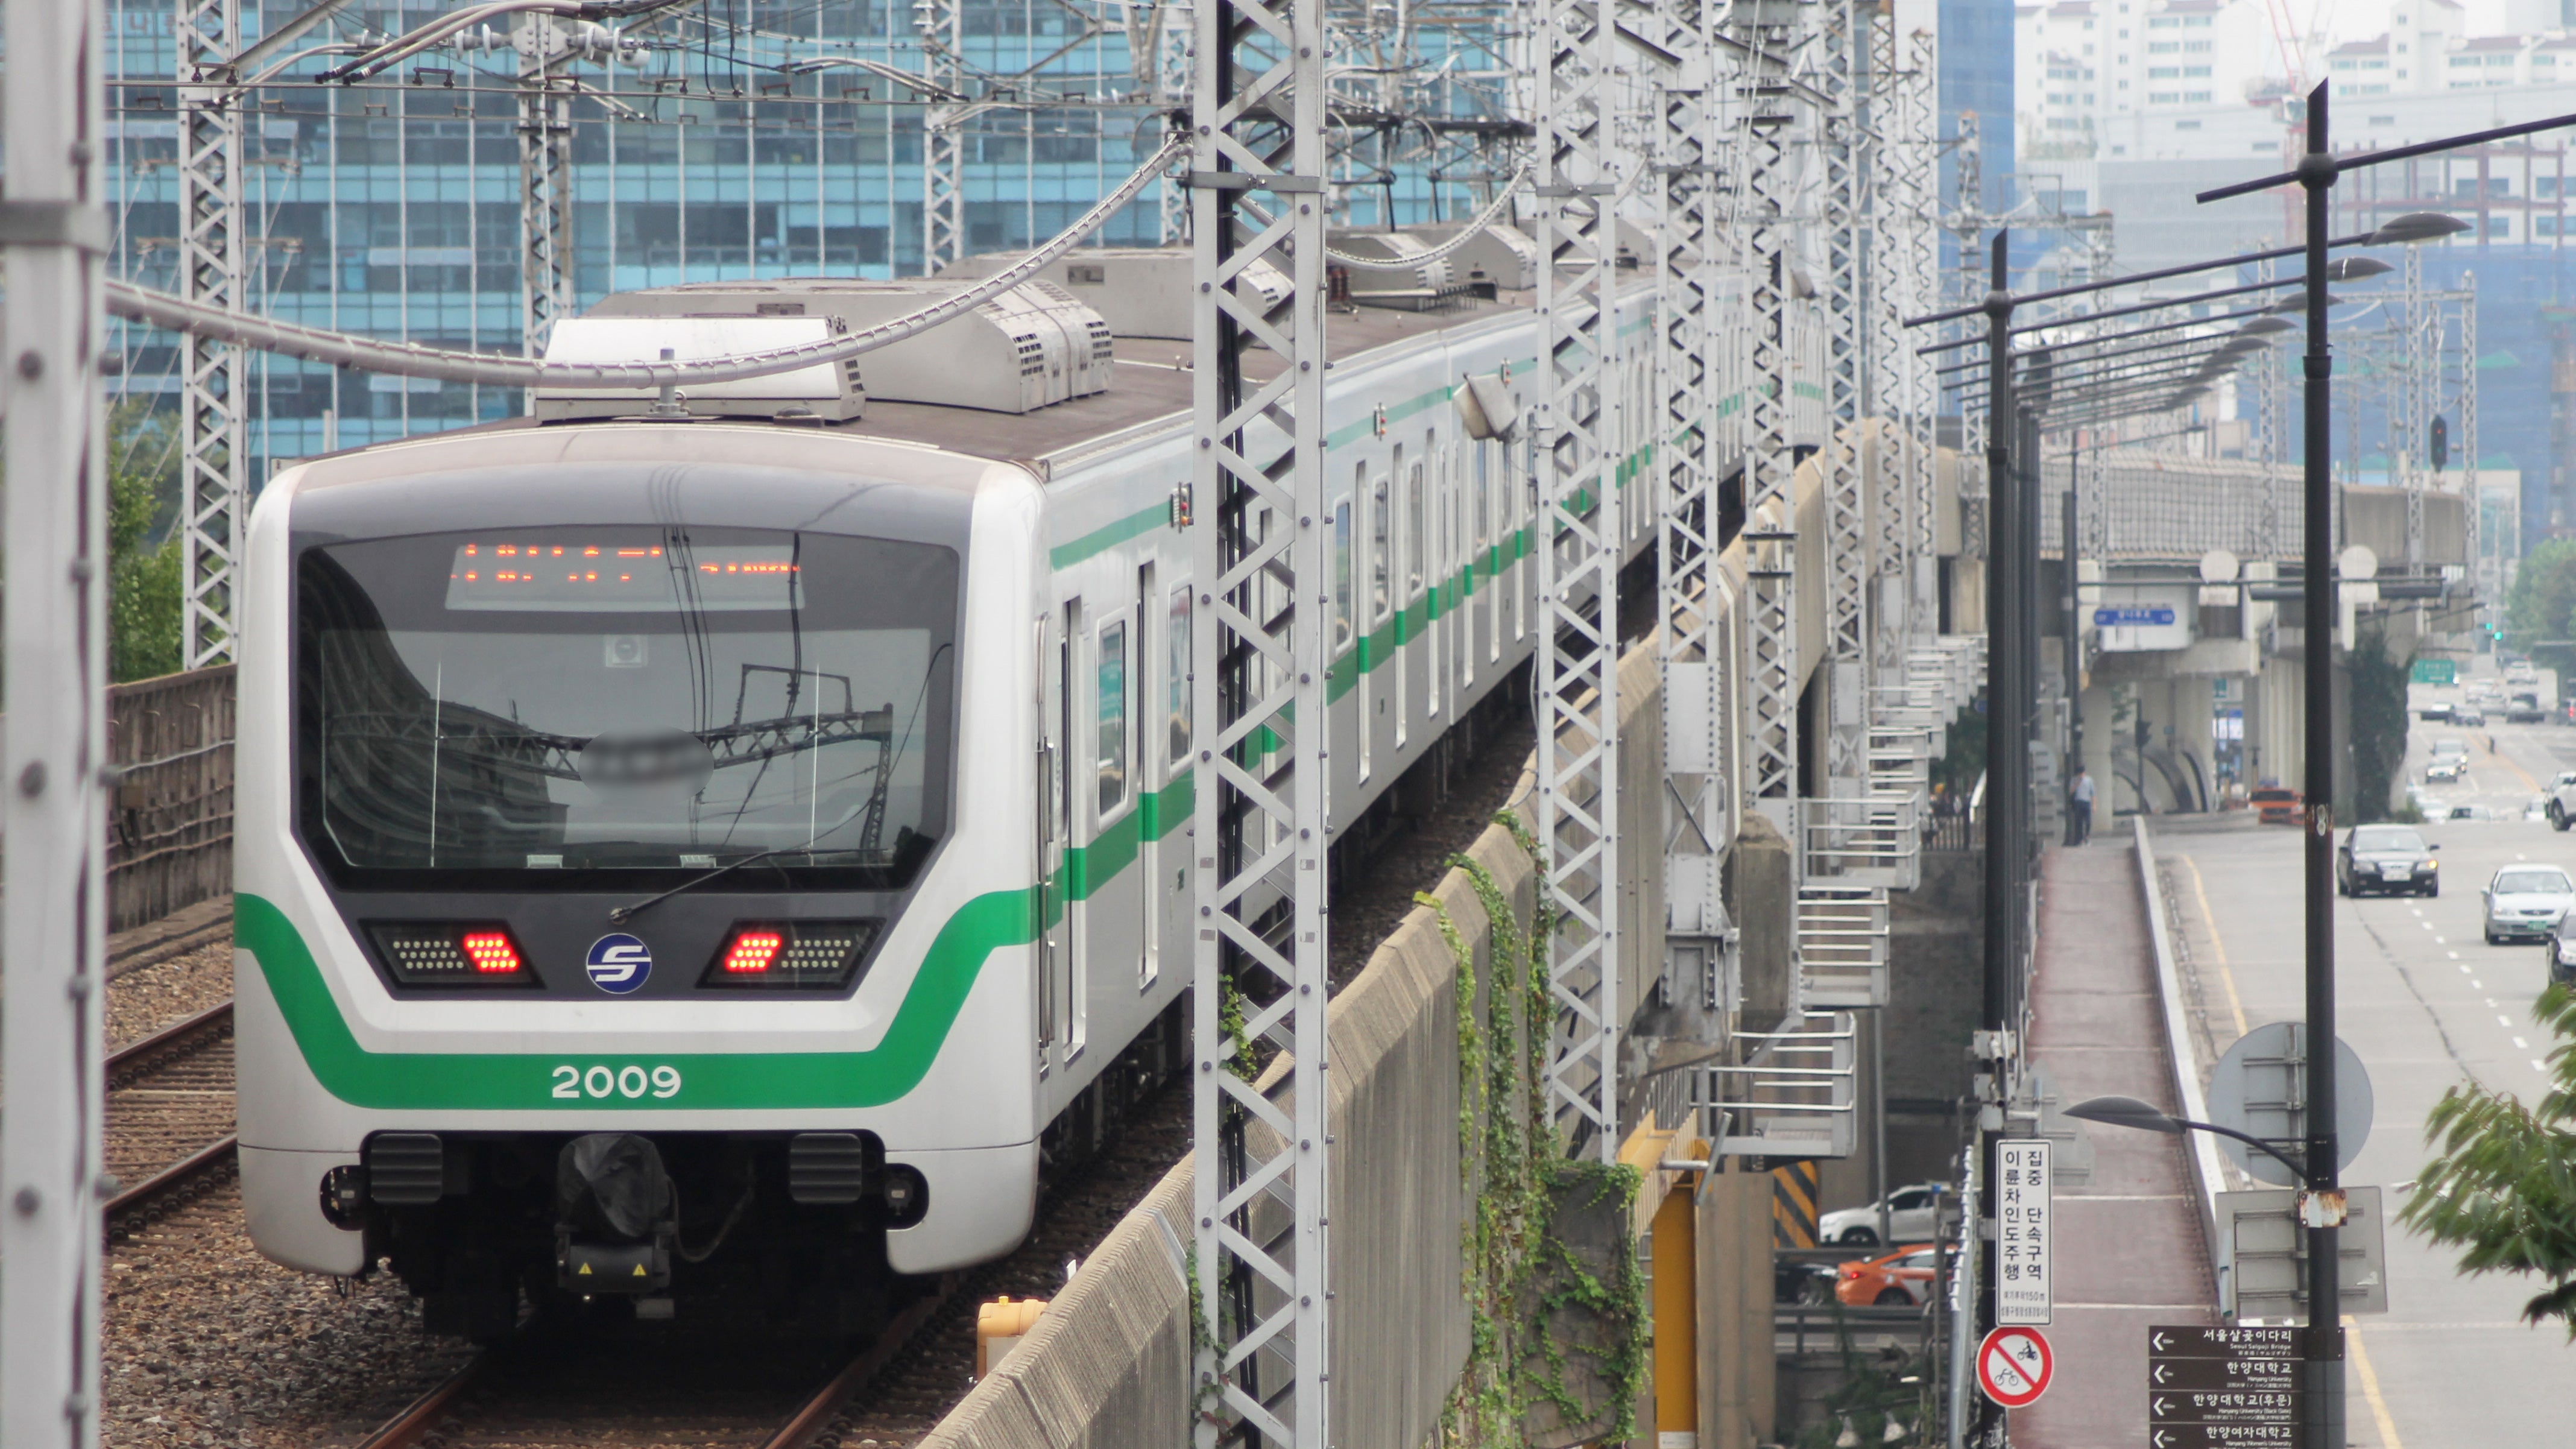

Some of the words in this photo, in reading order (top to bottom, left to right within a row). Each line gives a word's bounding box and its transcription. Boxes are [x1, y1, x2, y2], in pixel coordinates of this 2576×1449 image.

[552, 1065, 681, 1099] 2009
[2203, 1328, 2291, 1342] 서울살곶이다리
[2227, 1362, 2292, 1375] 한양대학교
[2193, 1394, 2291, 1407] 한양대학교(후문)
[2206, 1426, 2291, 1439] 한양여자대학교
